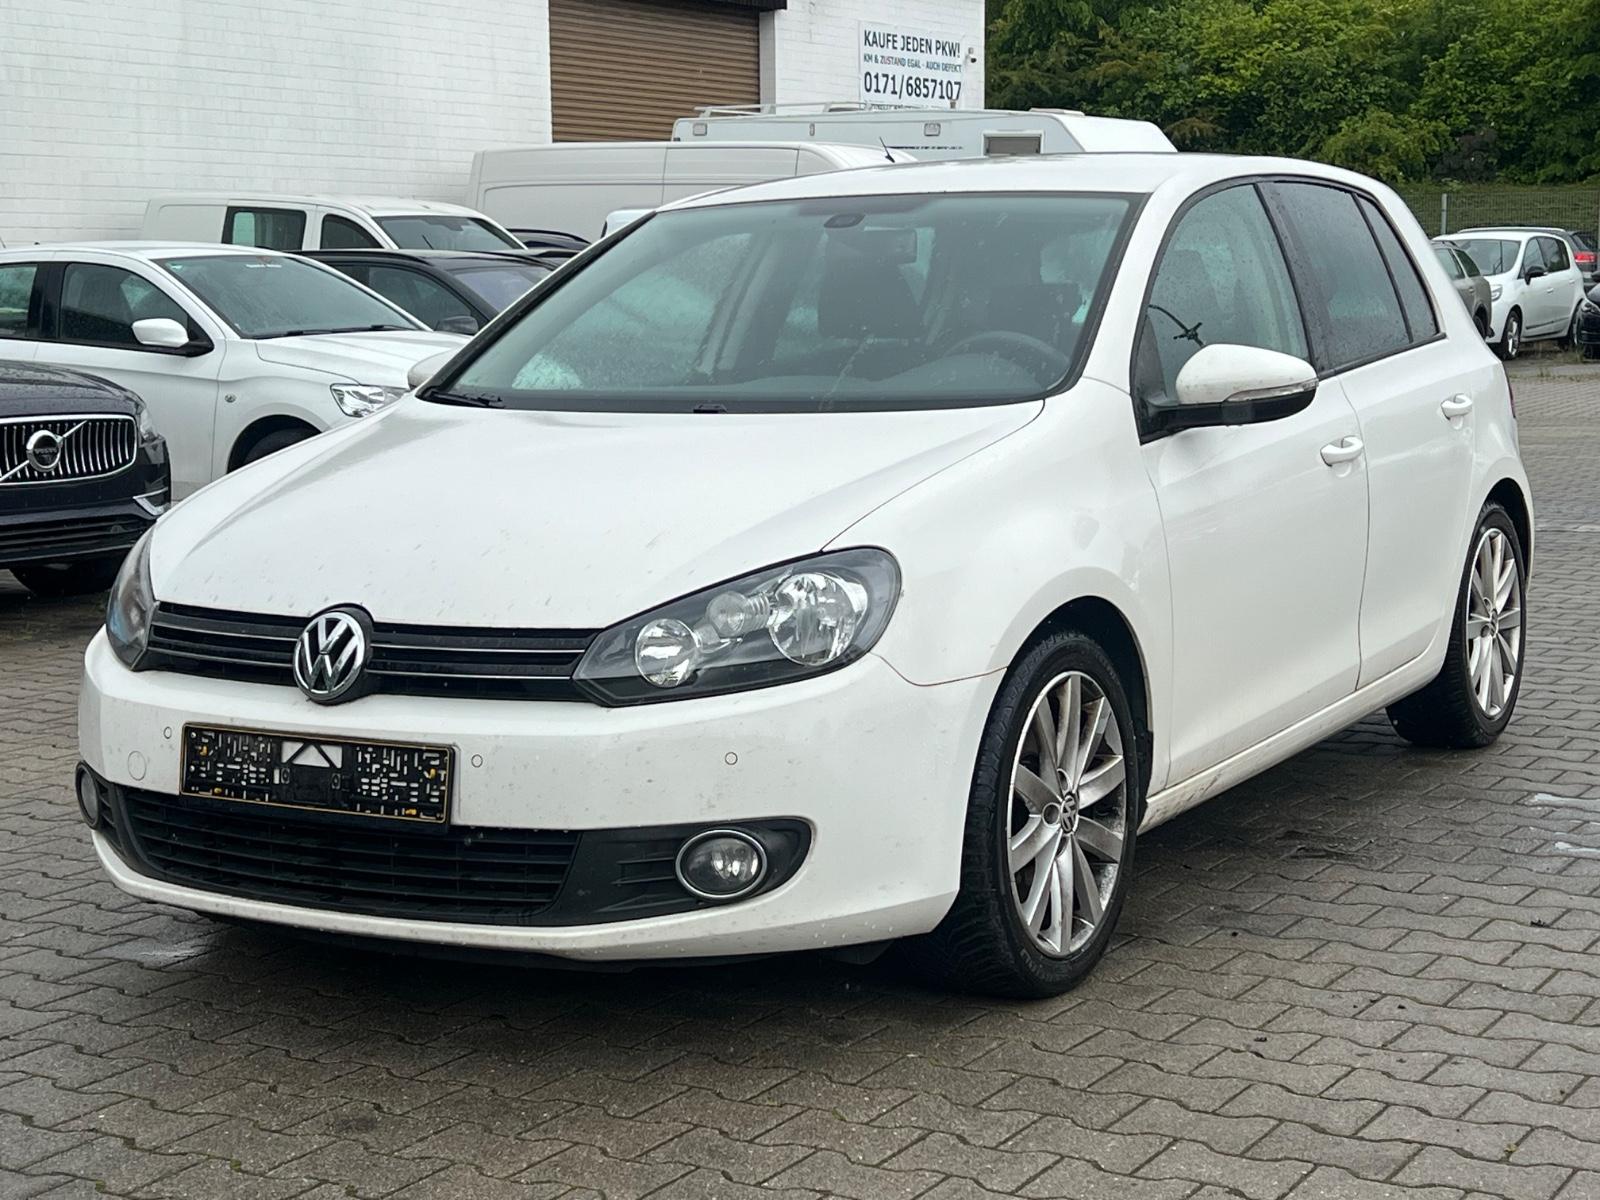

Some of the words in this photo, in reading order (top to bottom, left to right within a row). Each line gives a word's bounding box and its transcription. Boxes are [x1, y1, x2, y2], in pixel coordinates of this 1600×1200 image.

[864, 29, 898, 50] KAUFE
[900, 35, 932, 55] JEDEN
[935, 40, 961, 58] PKW!
[863, 53, 873, 63] KM
[874, 54, 879, 63] &
[880, 55, 906, 67] ZUSTAND
[907, 58, 921, 69] EGAL
[926, 61, 940, 71] AUCH
[941, 63, 962, 73] DEFEKT
[864, 71, 962, 101] 0171/6857107
